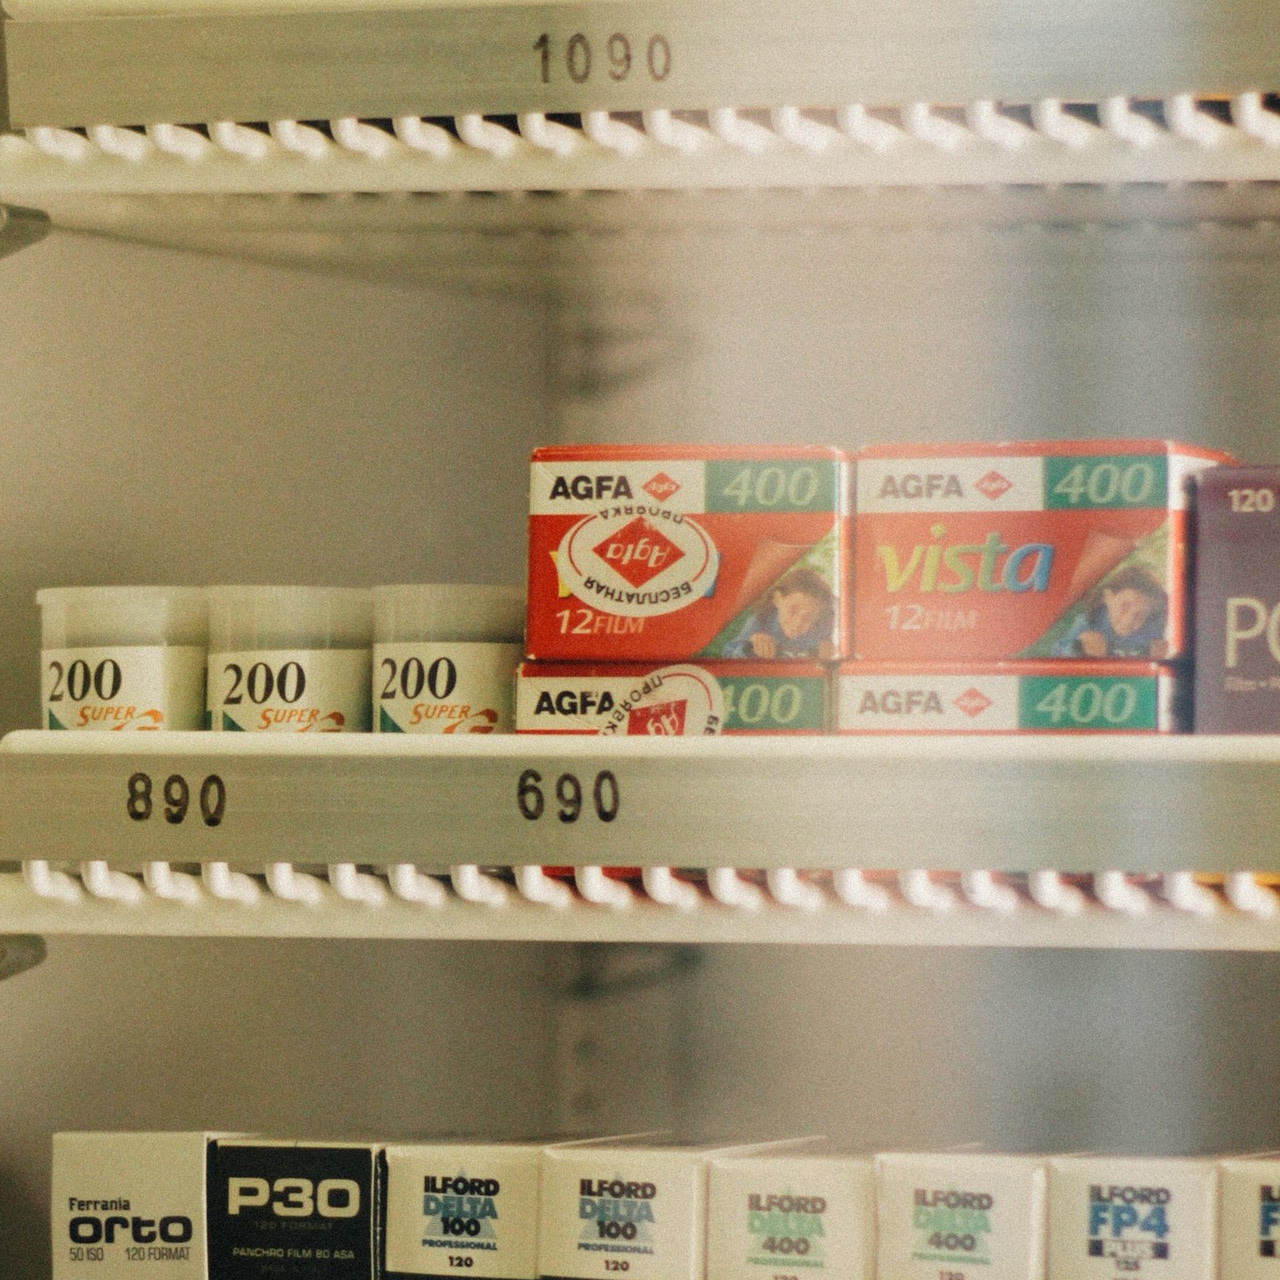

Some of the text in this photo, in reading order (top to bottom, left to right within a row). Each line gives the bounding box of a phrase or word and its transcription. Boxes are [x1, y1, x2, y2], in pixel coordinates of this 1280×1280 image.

[531, 31, 673, 84] 1090
[549, 467, 818, 507] AGFA 400
[879, 463, 1154, 504] AGFA 400
[1229, 489, 1275, 513] 120
[606, 539, 672, 569] Agfa
[877, 523, 1054, 593] vista
[583, 576, 693, 606] БЕСПЛАТНАЯ
[48, 658, 123, 704] 200
[223, 661, 307, 706] 200
[380, 656, 457, 700] 200
[410, 702, 470, 725] SUPER
[534, 691, 614, 715] AGFA
[859, 682, 1138, 723] AGFA 400
[80, 704, 136, 728] SUPER
[260, 707, 320, 729] SUPER
[126, 773, 227, 827] 890
[517, 769, 619, 824] 690
[228, 1177, 360, 1218] P30
[424, 1176, 500, 1196] ILFORD
[580, 1179, 656, 1199] ILFORD
[1089, 1185, 1172, 1204] ILFORD
[70, 1198, 130, 1211] Ferrania
[423, 1195, 498, 1219] DELTA
[579, 1199, 655, 1223] DELTA
[748, 1194, 826, 1214] ILFORD
[914, 1189, 993, 1211] ILFORD
[70, 1216, 193, 1244] orto
[440, 1217, 481, 1236] 100
[597, 1221, 638, 1240] 100
[1089, 1203, 1170, 1239] FP4
[70, 1247, 191, 1261] 50 ISO 120 FORMAT
[233, 1247, 284, 1258] PANCHRO
[287, 1248, 312, 1259] FILM
[334, 1249, 354, 1259] ASA
[422, 1239, 498, 1251] PROFESSIONAL
[578, 1242, 654, 1254] PROFESSIONAL
[762, 1235, 811, 1255] 400
[928, 1232, 977, 1252] 400
[449, 1256, 474, 1268] 120
[604, 1260, 629, 1271] 120
